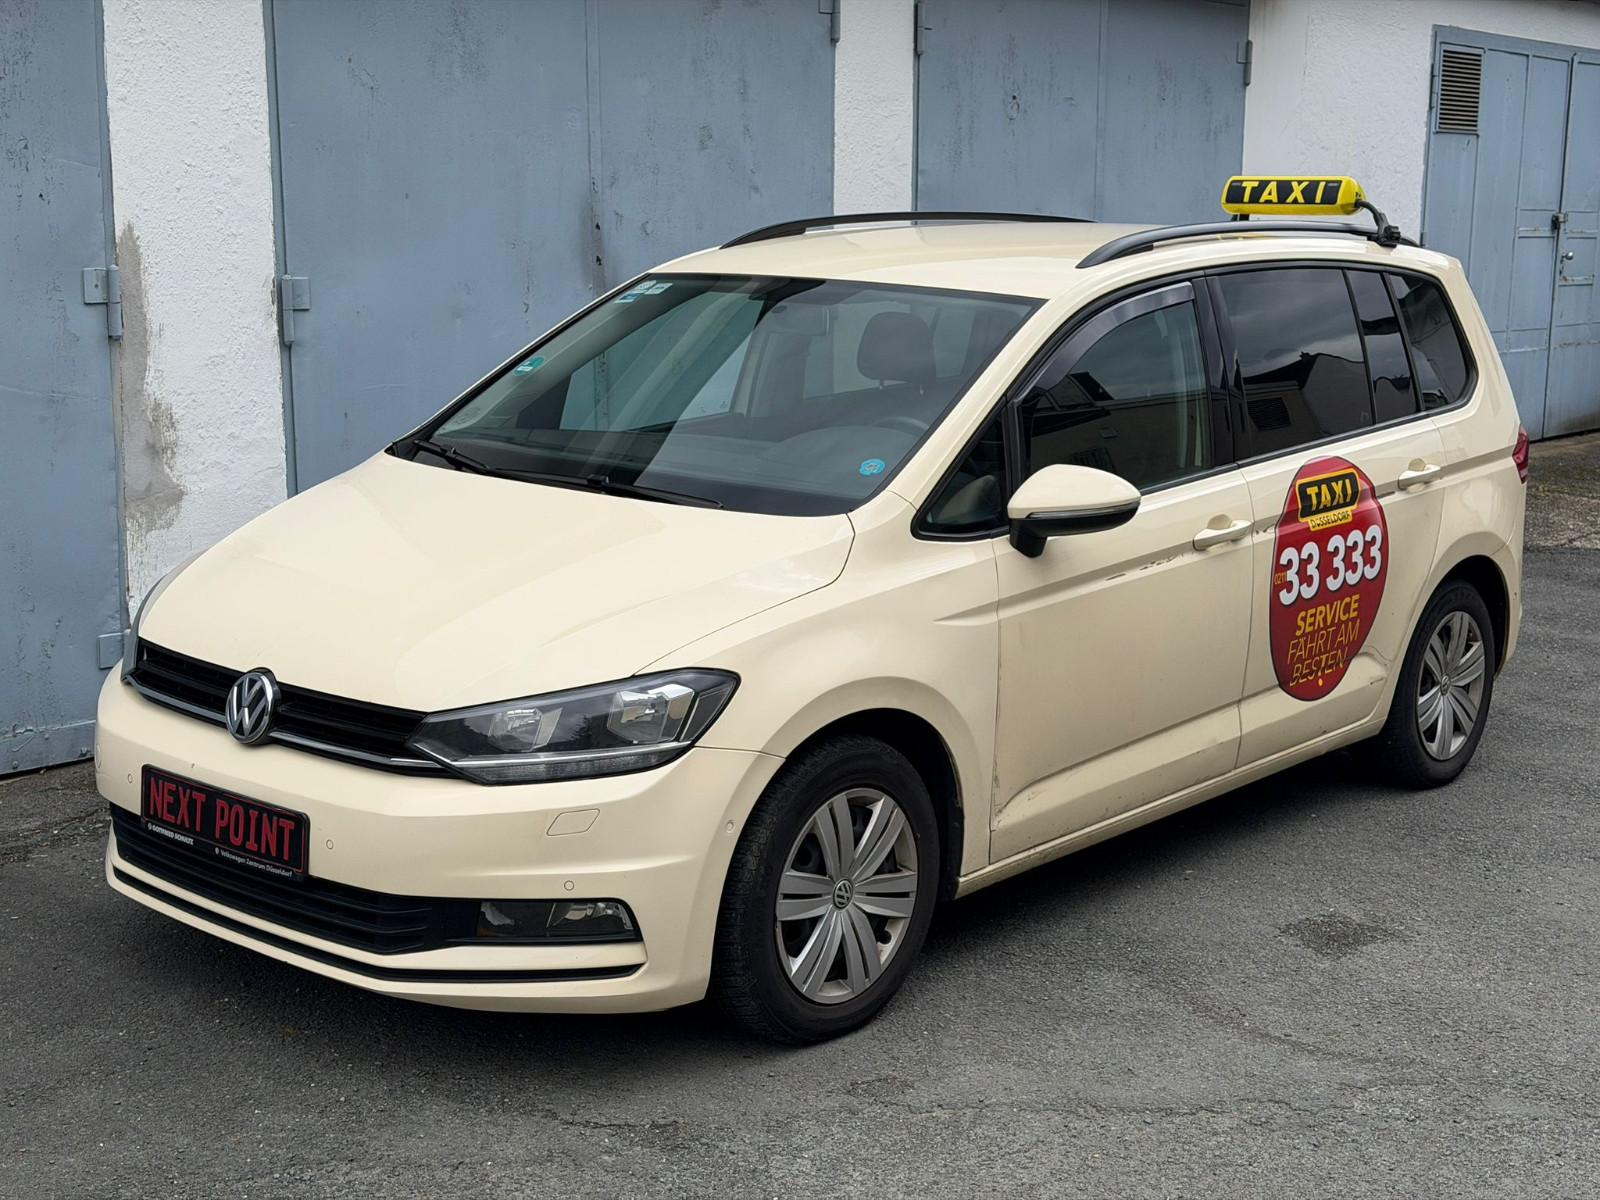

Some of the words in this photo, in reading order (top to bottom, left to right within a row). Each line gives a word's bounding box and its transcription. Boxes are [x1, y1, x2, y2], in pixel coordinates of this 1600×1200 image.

[1241, 181, 1327, 203] TAXI
[1306, 478, 1352, 511] TAXI
[1279, 541, 1320, 606] 33
[1326, 524, 1383, 592] 333
[1295, 594, 1361, 637] SERVICE
[1287, 627, 1337, 664] FÄHRT
[1335, 619, 1361, 648] AM
[150, 777, 206, 833] NEXT
[215, 798, 295, 861] POINT
